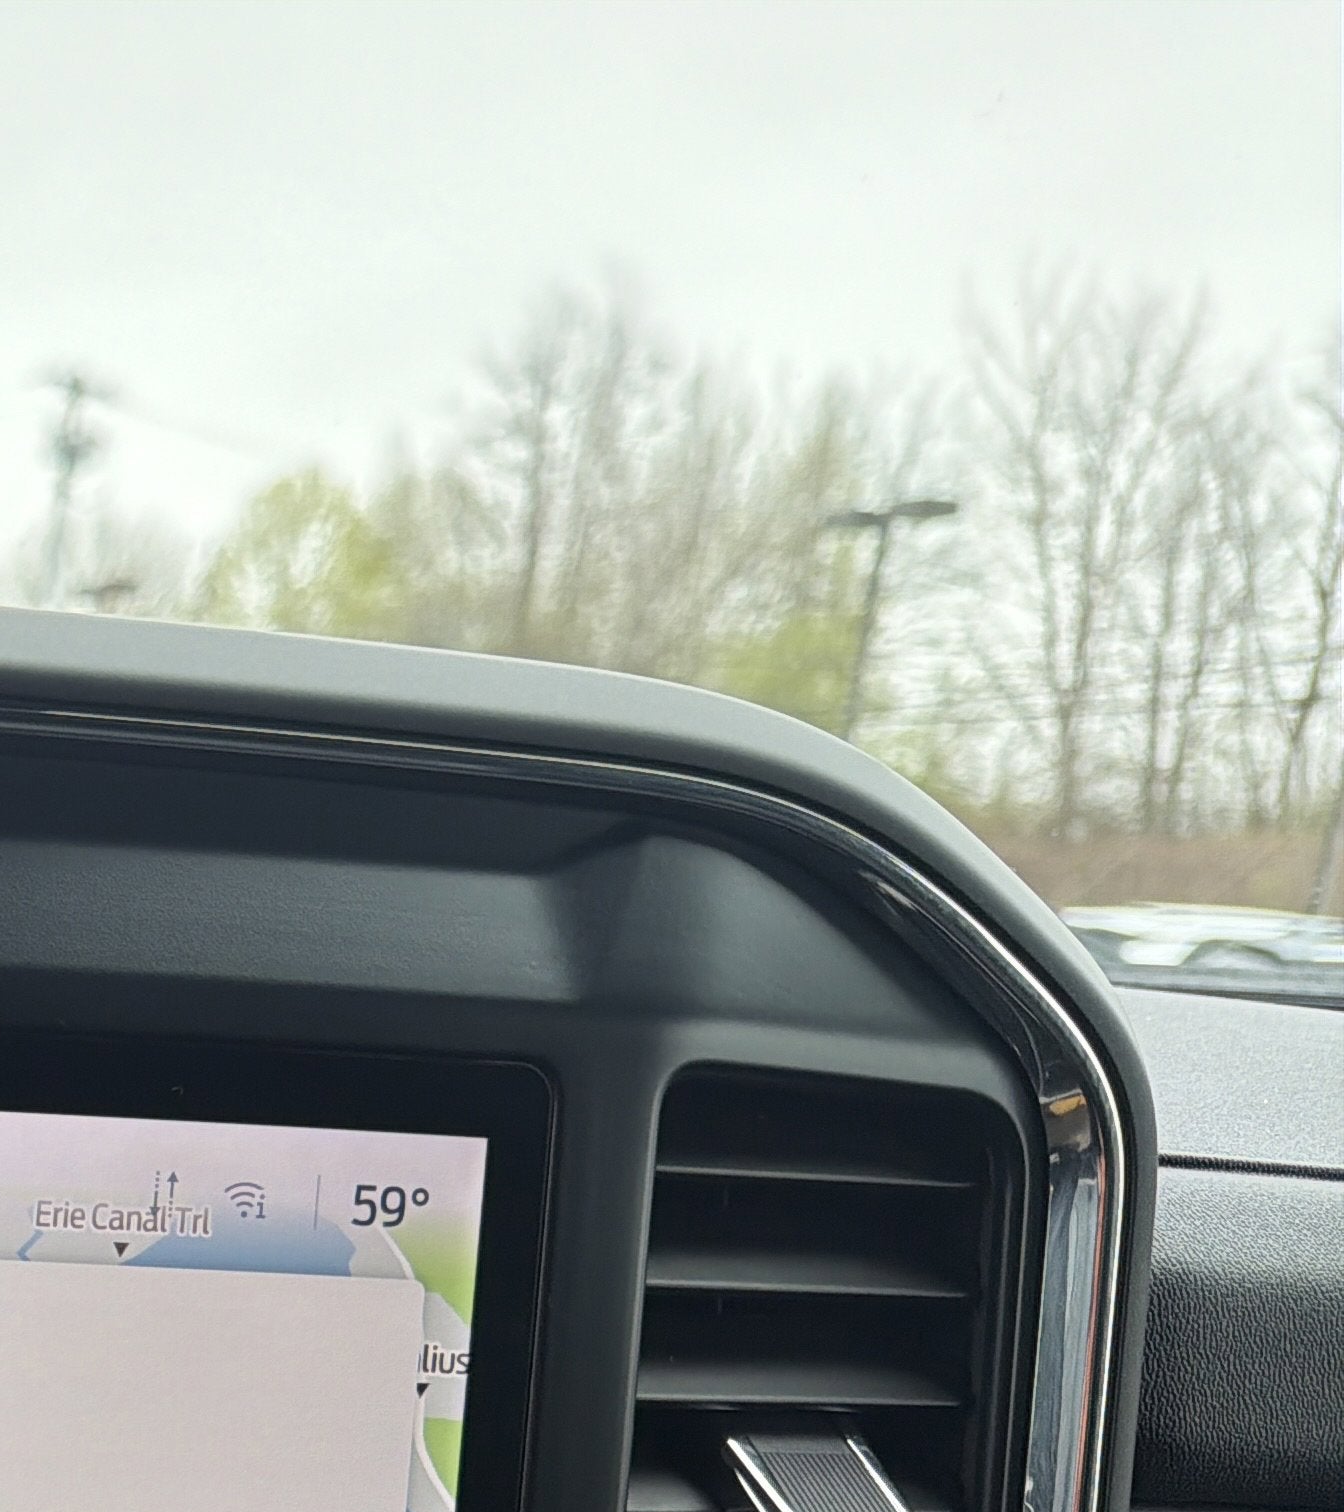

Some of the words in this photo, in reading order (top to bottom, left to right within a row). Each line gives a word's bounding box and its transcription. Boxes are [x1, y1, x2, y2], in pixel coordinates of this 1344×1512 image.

[35, 1200, 86, 1230] Erie
[92, 1203, 169, 1233] Canal
[175, 1208, 210, 1235] Trl
[417, 1344, 470, 1375] lius
